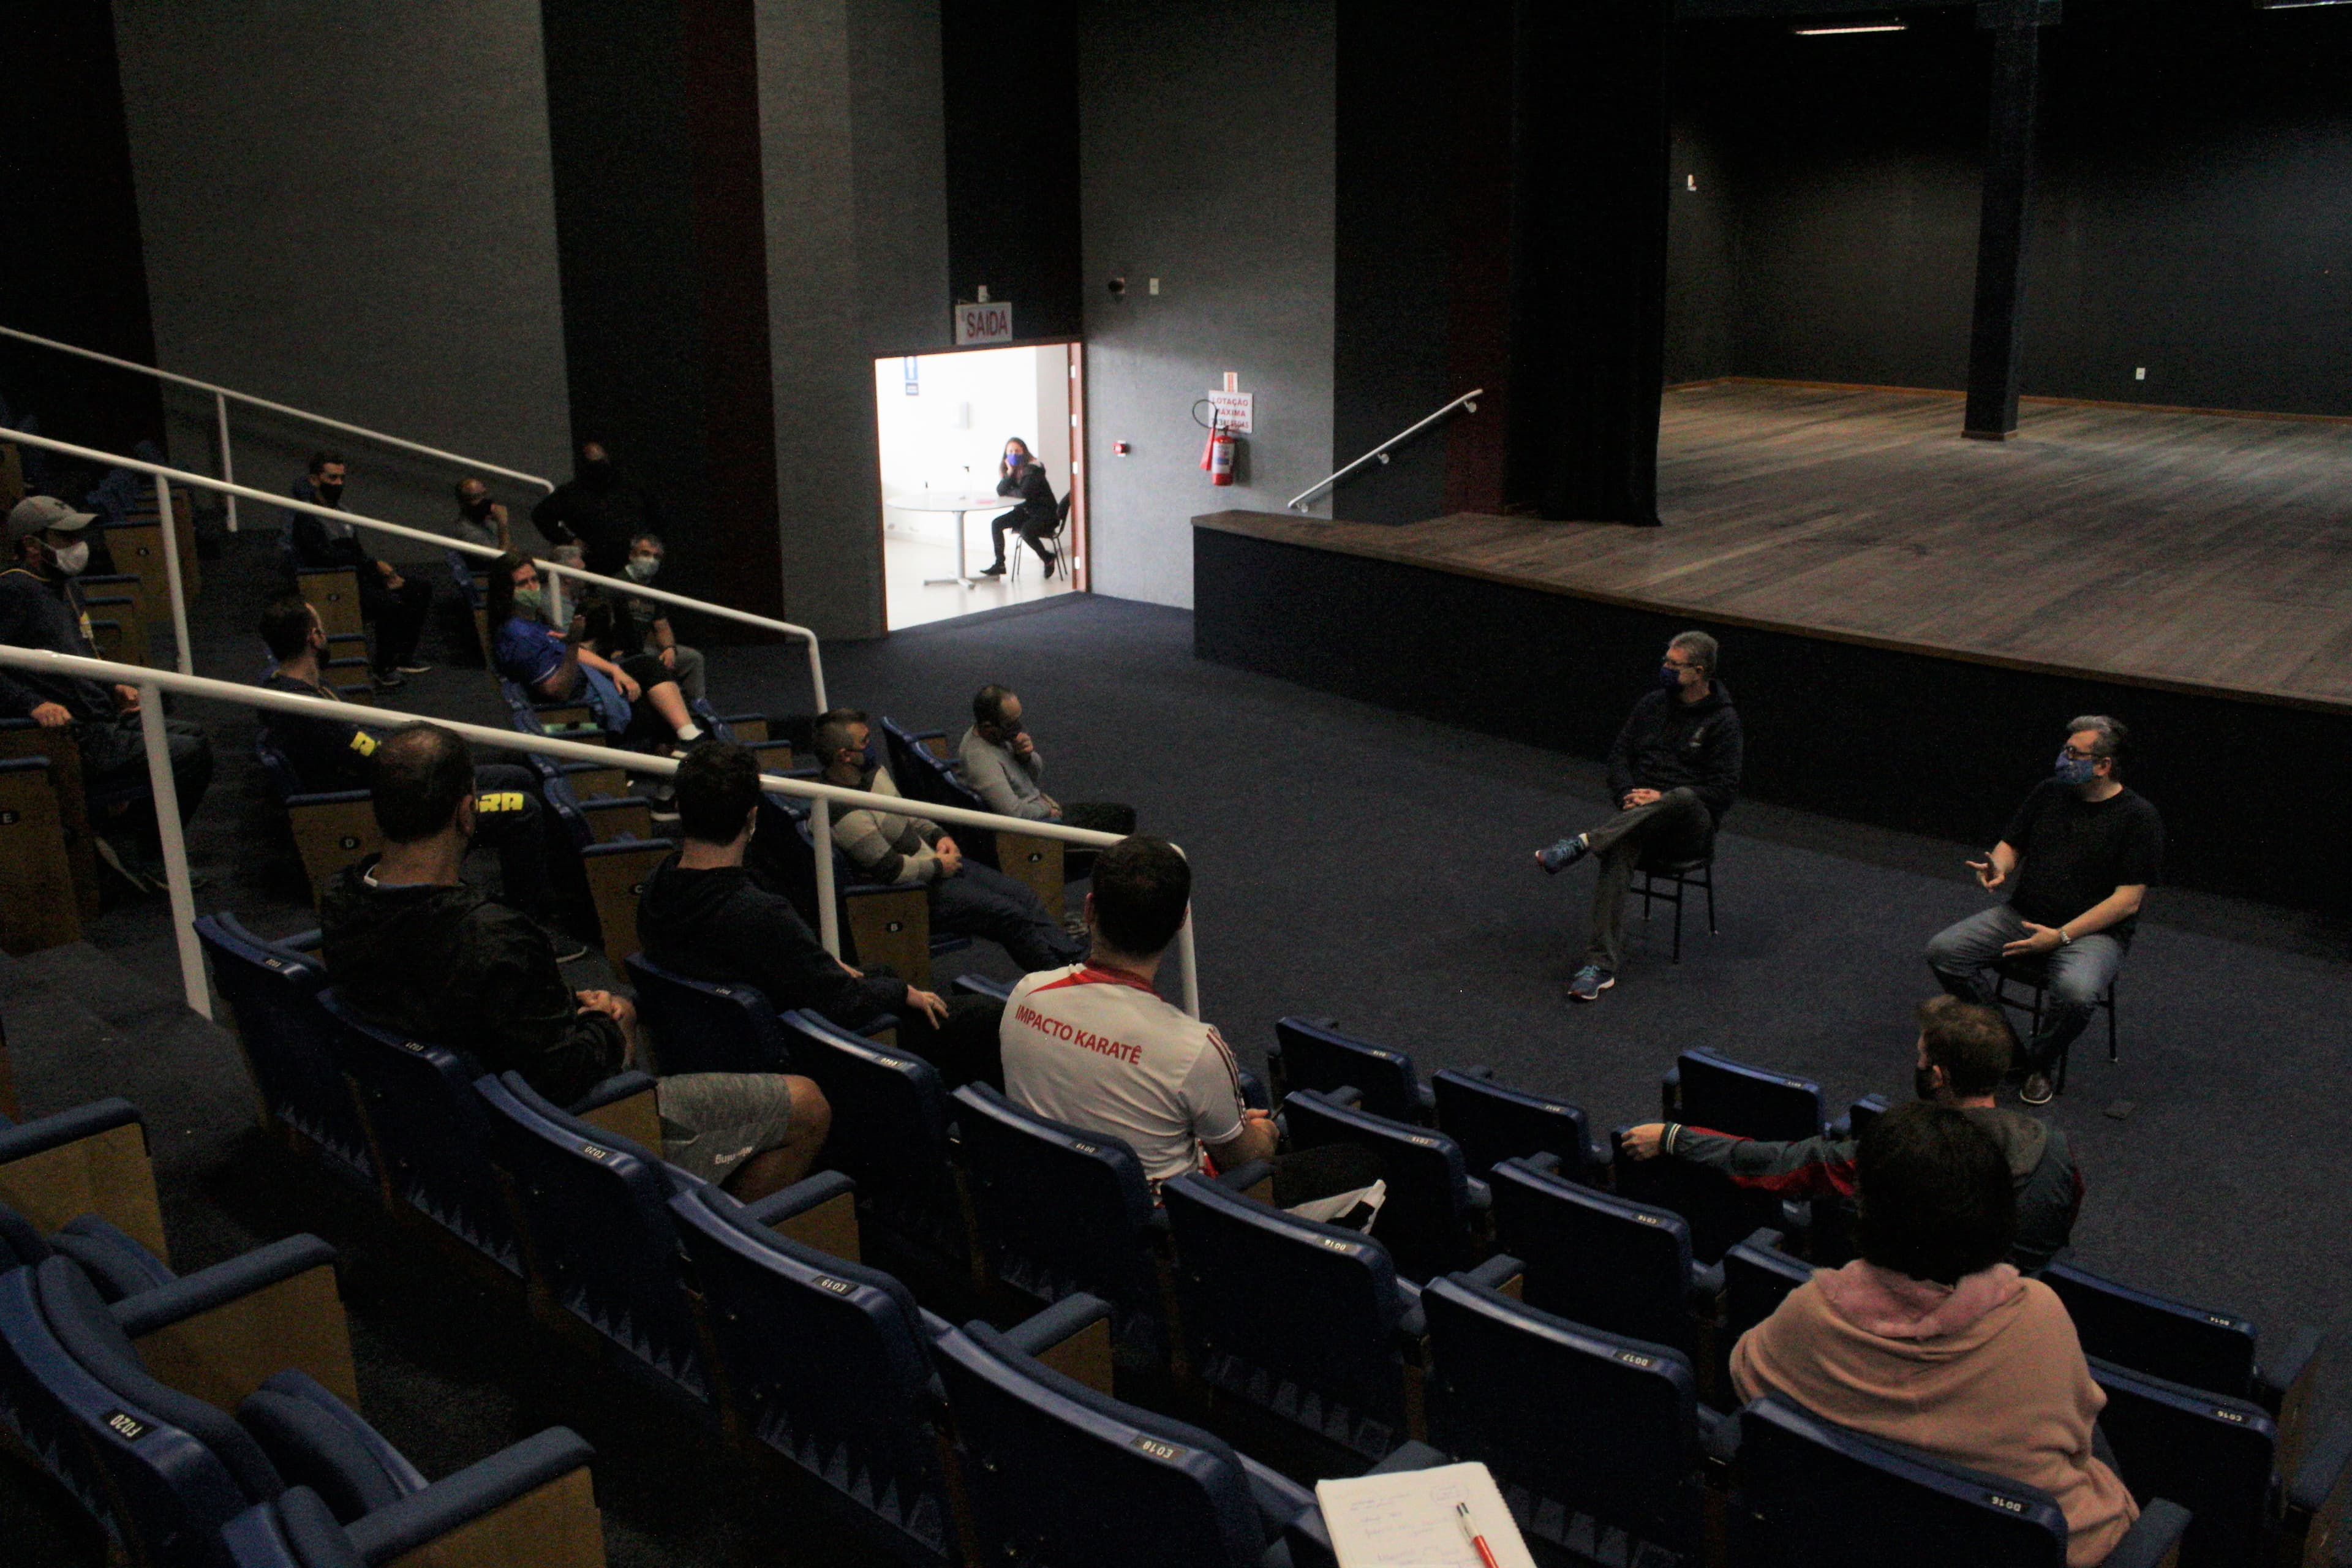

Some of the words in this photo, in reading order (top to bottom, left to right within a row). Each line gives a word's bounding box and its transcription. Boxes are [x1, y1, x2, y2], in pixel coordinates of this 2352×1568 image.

[967, 309, 1009, 337] SAIDA
[1212, 397, 1249, 407] LOTAÇÃO
[1015, 1004, 1073, 1041] IMPACTO
[1074, 1029, 1143, 1065] KARATÊ
[584, 1146, 606, 1159] E020
[821, 1279, 848, 1292] E019
[1623, 1354, 1648, 1366] D017
[110, 1414, 143, 1438] F020
[1142, 1441, 1174, 1458] E018
[1991, 1496, 2022, 1512] D016
